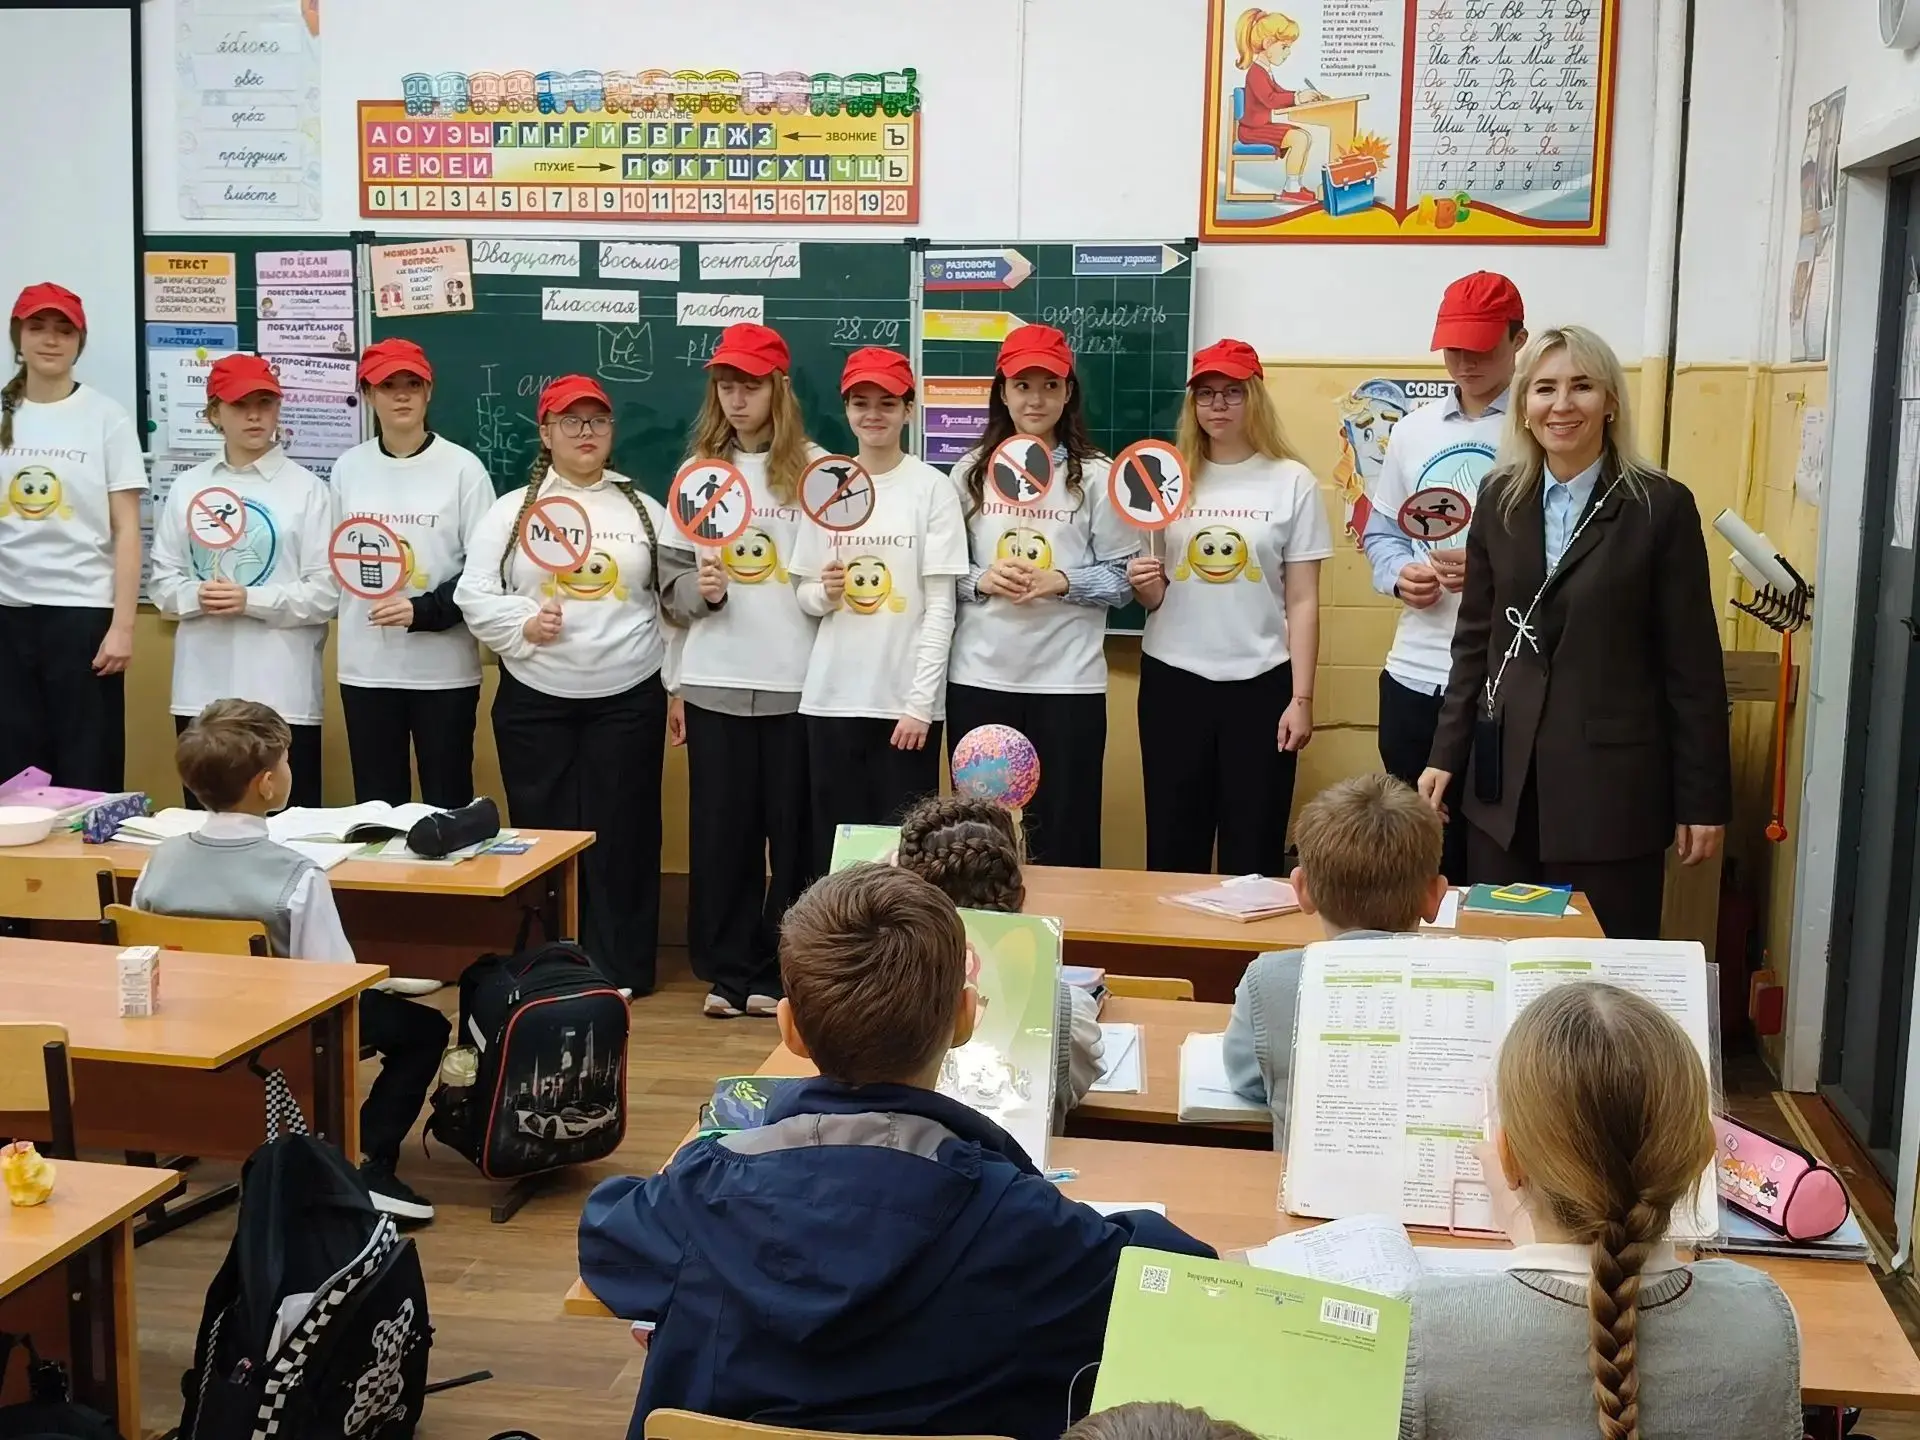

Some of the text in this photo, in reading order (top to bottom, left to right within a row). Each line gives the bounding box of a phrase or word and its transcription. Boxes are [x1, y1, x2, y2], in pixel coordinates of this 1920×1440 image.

[372, 123, 904, 148] А О У Э Ы Л М Н Р Й Б В Г Д Ж З ЗВОНКИЕ Ъ
[372, 154, 902, 180] Я Ё Ю Е И ГЛУХИЕ П Ф К Т Ш С Х Ц Ч Щ Ь
[1440, 162, 1562, 171] 1 2 3 4 5
[1438, 180, 1561, 190] 6 7 8 9 0
[375, 191, 904, 211] 0 1 2 3 4 5 6 7 8 9 10 11 12 13 14 15 16 17 18 19 20
[384, 246, 455, 257] МОЖНО ЗАДАТЬ
[168, 259, 208, 270] ТЕКСТ
[280, 257, 294, 266] ПО
[473, 242, 799, 277] Двадцать восьмое сентября
[946, 261, 996, 269] РАЗГОВОРЫ
[260, 269, 349, 279] ВЫСКАЗЫВАНИЯ
[955, 271, 996, 279] ВАЖНОМ!
[545, 290, 761, 324] Классная работа
[267, 323, 344, 331] ПОБУДИТЕЛЬНОЕ
[834, 316, 900, 345] 28.09
[271, 357, 350, 371] ВОПРОСИТЕЛЬНОЕ
[480, 364, 501, 396] I
[1405, 382, 1456, 396] СОВЕТ
[751, 507, 800, 522] МИСТ
